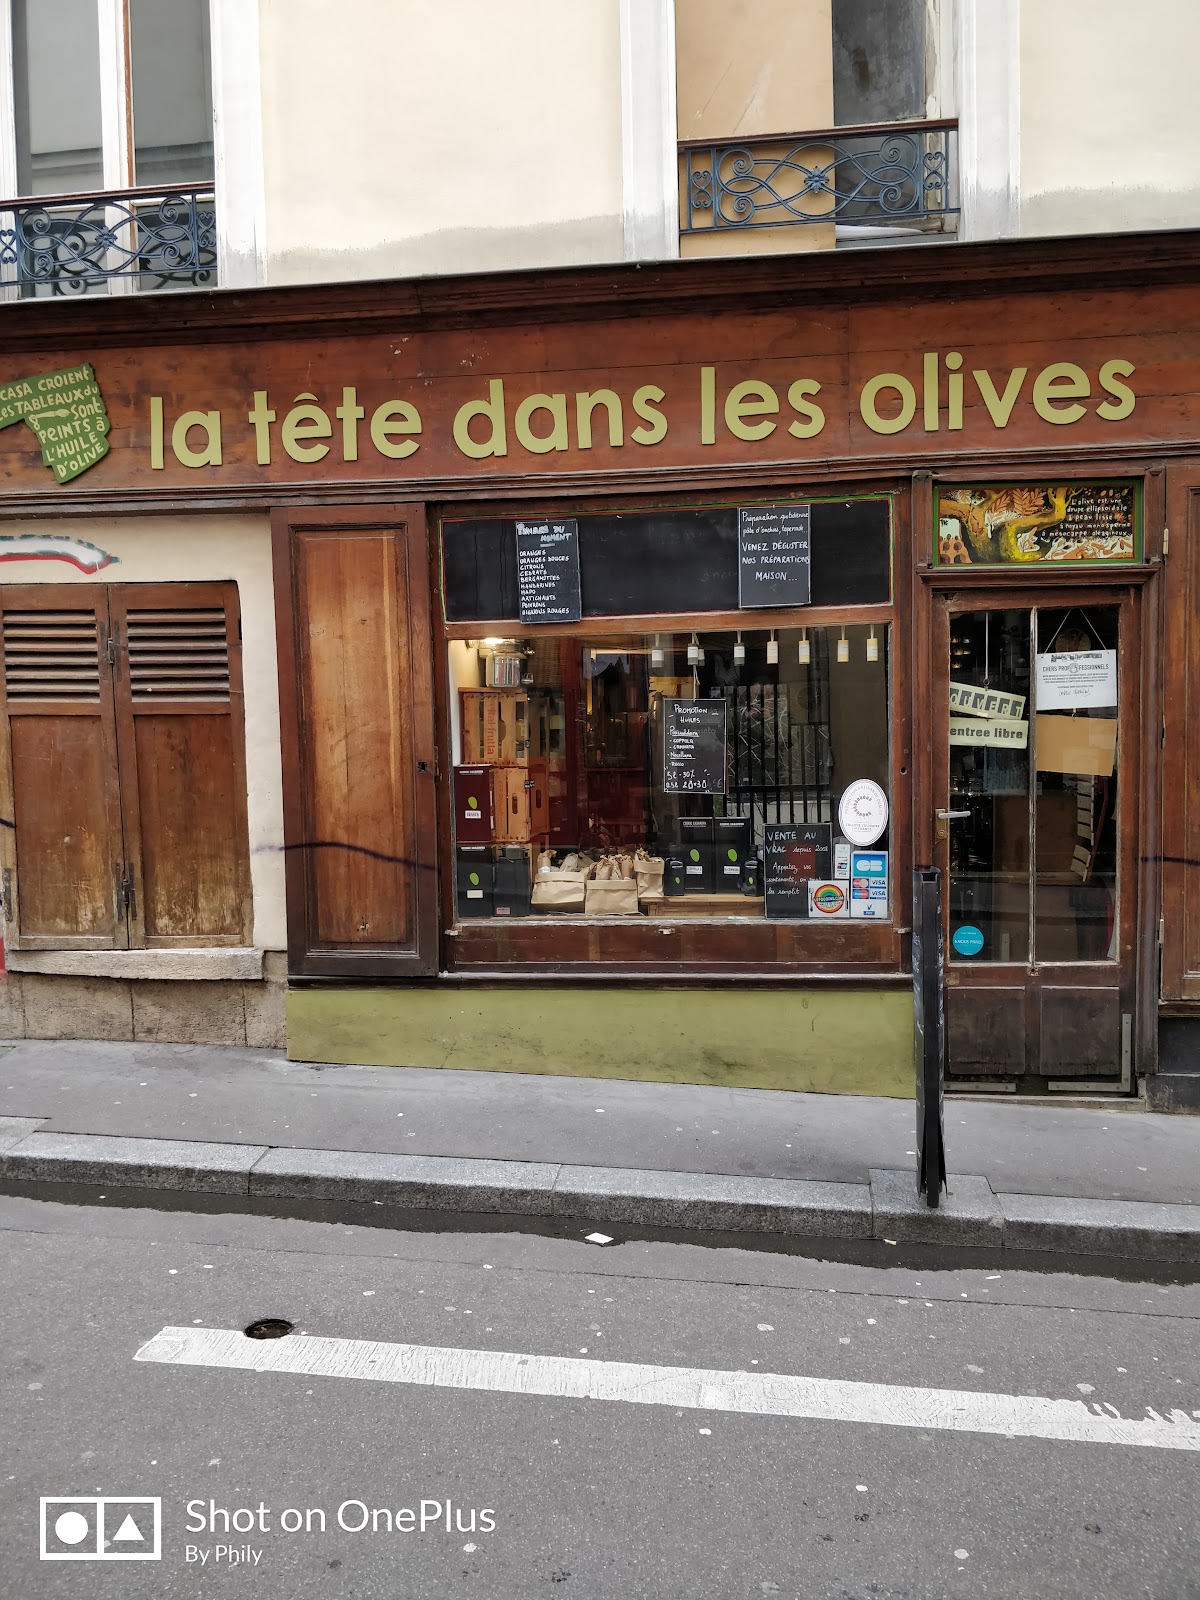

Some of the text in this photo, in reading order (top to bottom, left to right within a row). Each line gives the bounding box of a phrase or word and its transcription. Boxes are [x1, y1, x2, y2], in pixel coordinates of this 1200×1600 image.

[14, 388, 85, 415] TABLEAUX
[84, 384, 98, 396] du
[150, 351, 1136, 468] la tête dans les olives
[45, 431, 98, 462] L'HUILE
[742, 542, 769, 552] VENEZ
[519, 556, 546, 564] ORANGES
[742, 557, 757, 565] NOS
[519, 563, 545, 571] CITRONS
[546, 607, 570, 615] ROUGES
[674, 703, 708, 714] PROMOTION
[949, 690, 1023, 718] OUVERT
[950, 726, 1023, 739] entree libre
[766, 831, 817, 842] VENTE AU
